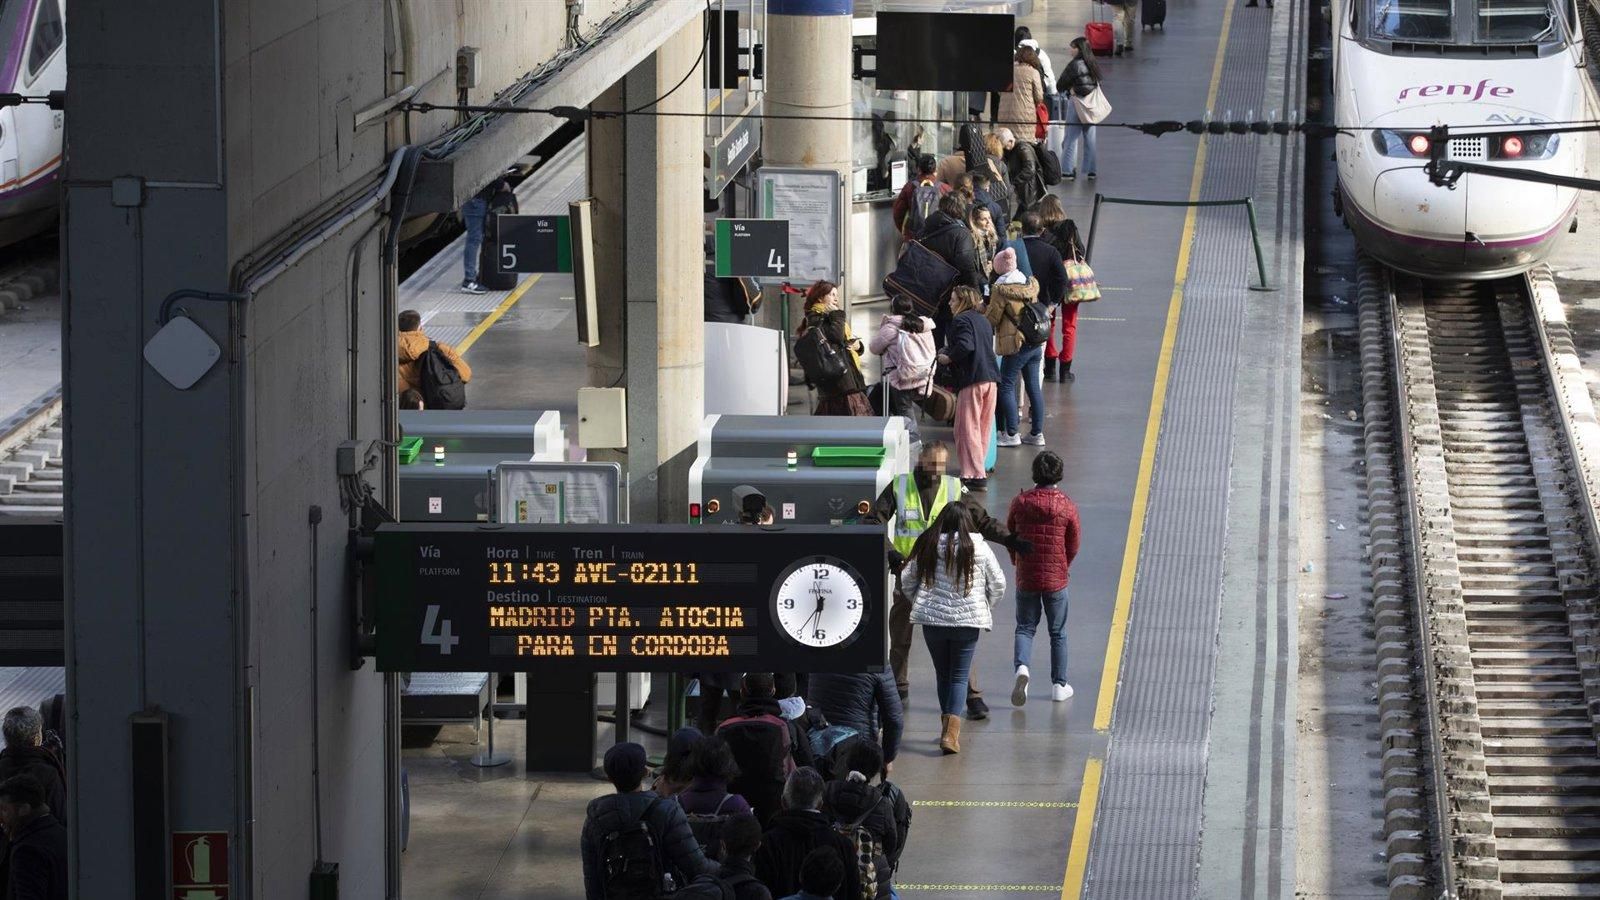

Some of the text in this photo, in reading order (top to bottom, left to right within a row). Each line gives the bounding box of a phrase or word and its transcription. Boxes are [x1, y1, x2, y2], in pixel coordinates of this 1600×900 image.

[1398, 78, 1515, 102] renfe
[1485, 113, 1545, 128] AVE
[502, 244, 517, 269] 5
[767, 248, 785, 273] 4
[420, 545, 441, 559] Vía
[487, 547, 556, 559] Hora TIME
[573, 547, 644, 559] Tren TRAIN
[419, 567, 460, 576] PLATFORM
[489, 562, 699, 583] 11:43 AVE-02111
[812, 568, 829, 580] 12
[487, 590, 607, 603] Destino DESTINATION
[784, 598, 795, 609] 9
[846, 598, 858, 610] 3
[490, 606, 744, 627] MADRID PTA. ATOCHA
[421, 604, 459, 655] 4
[815, 629, 826, 640] 6
[518, 635, 730, 656] PARA EN CORDOBA
